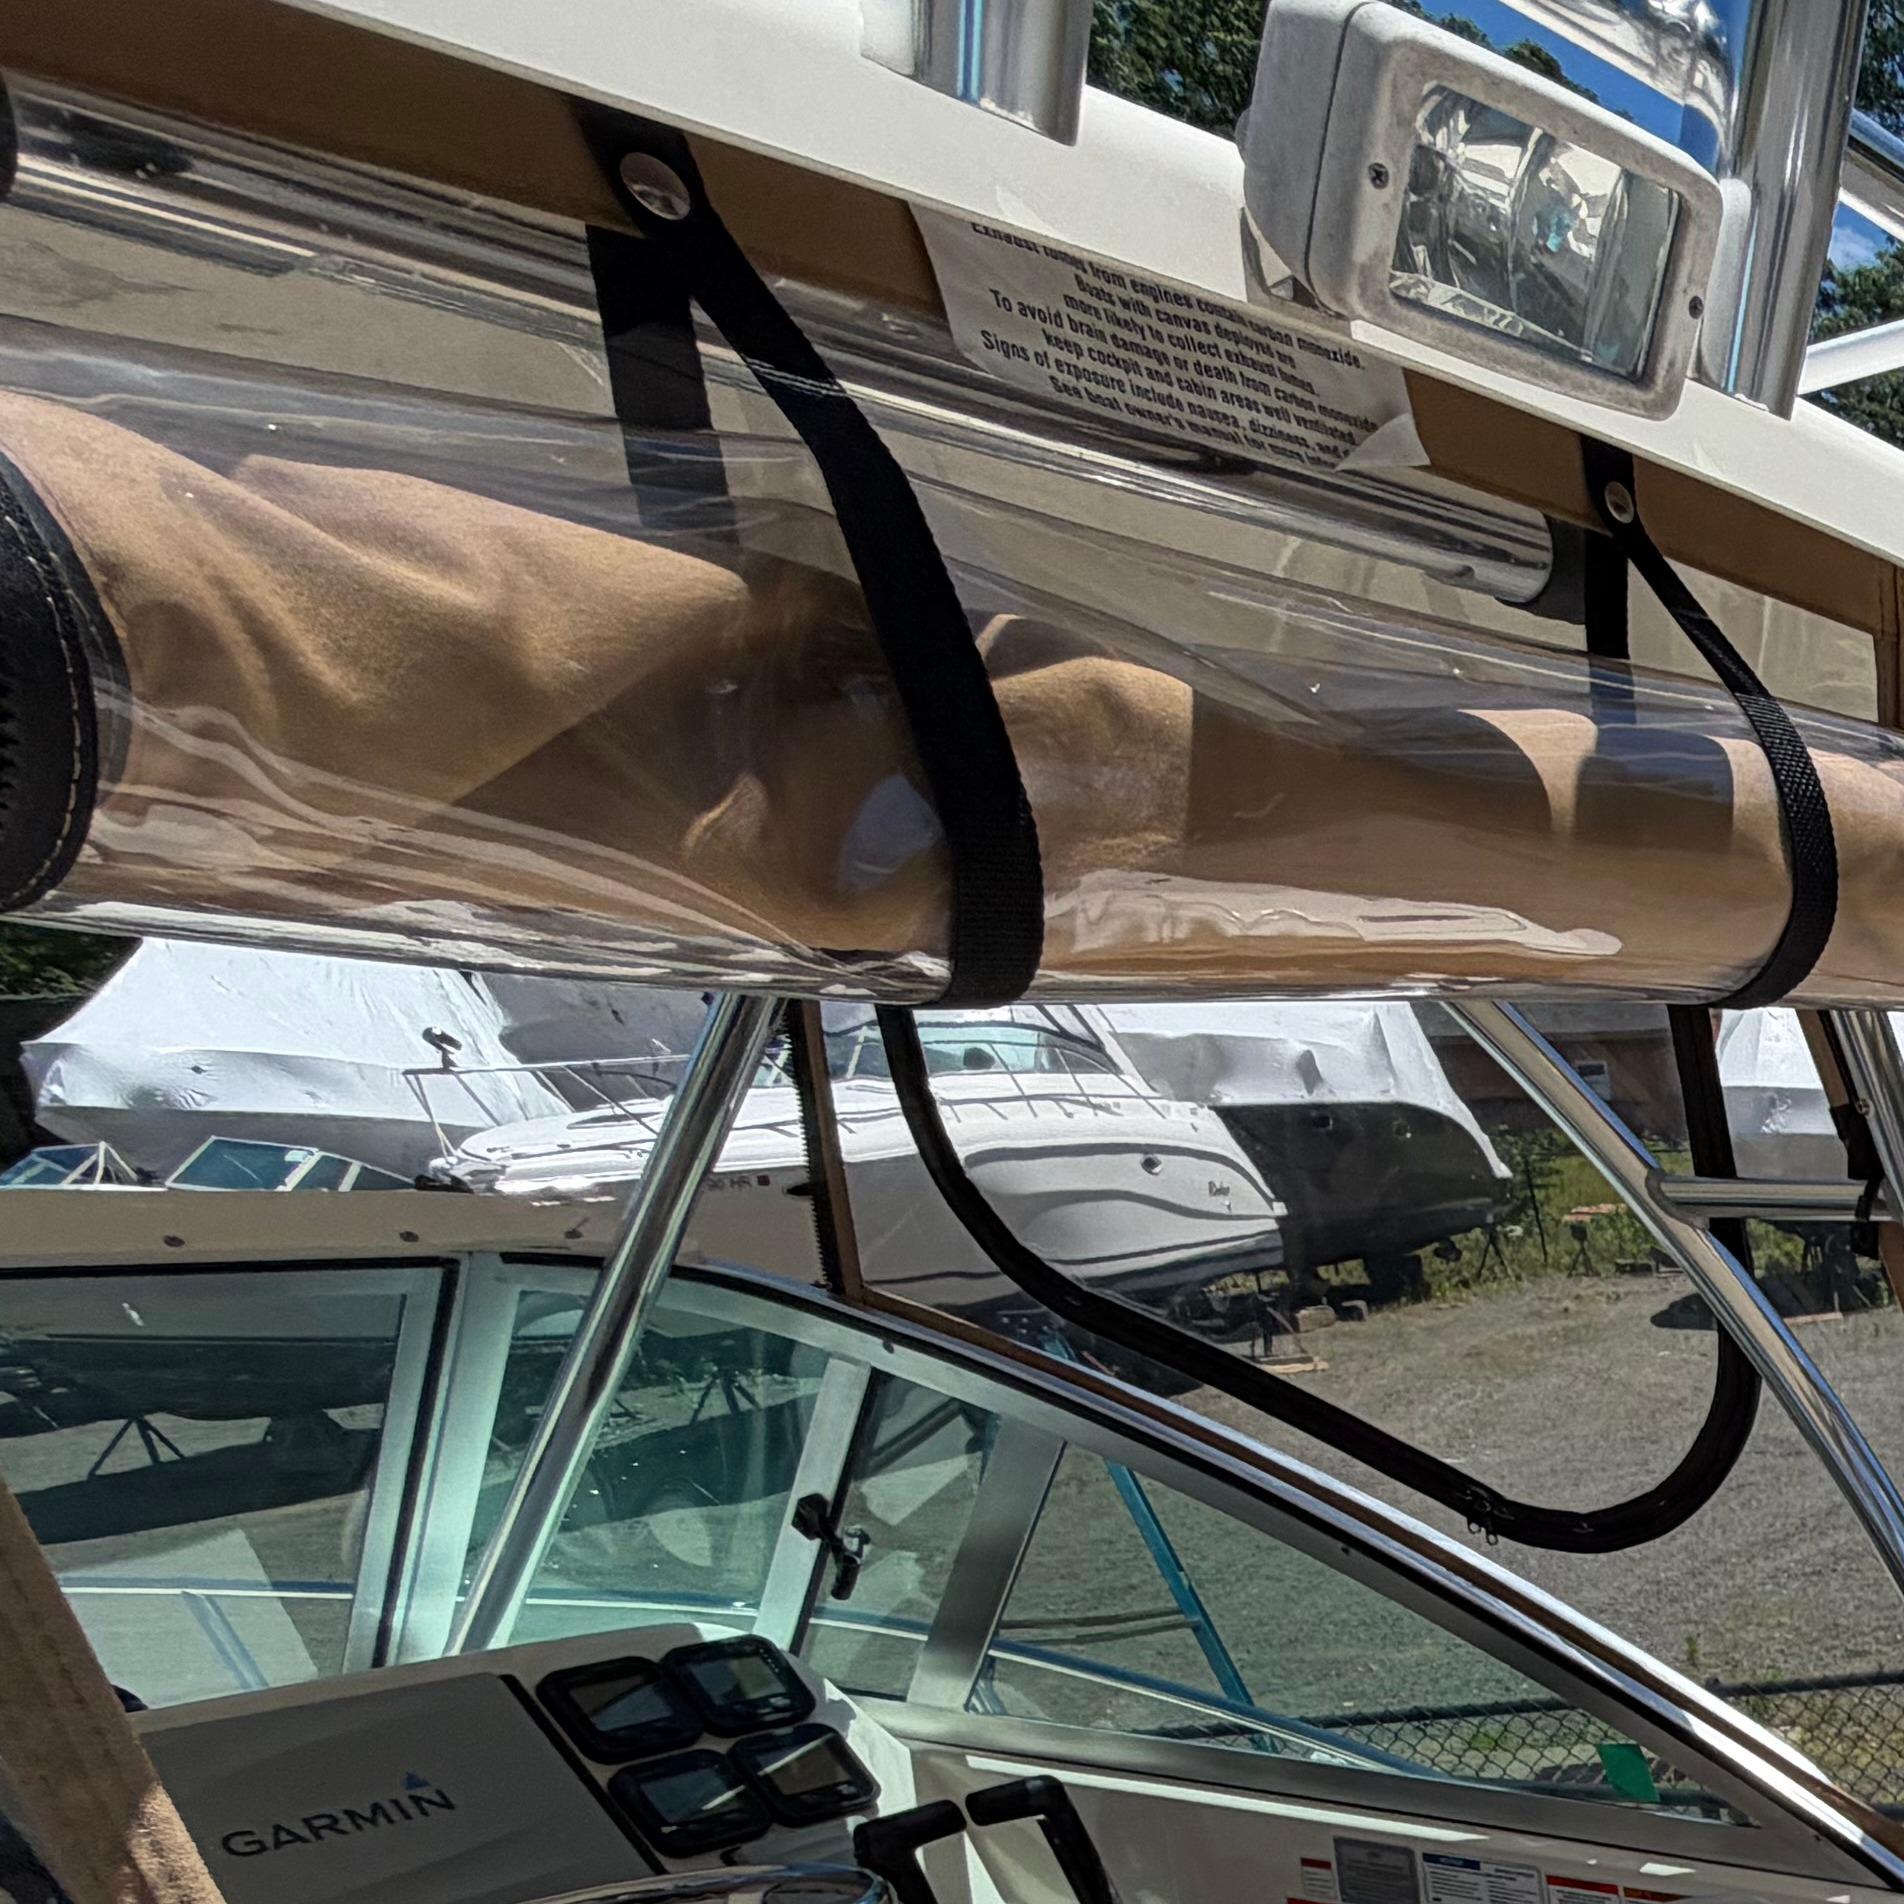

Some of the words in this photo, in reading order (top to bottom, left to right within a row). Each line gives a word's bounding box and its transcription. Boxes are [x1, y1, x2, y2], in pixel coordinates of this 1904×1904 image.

[1088, 261, 1128, 290] from
[1130, 278, 1194, 309] engines
[1117, 294, 1153, 318] with
[1155, 308, 1211, 335] canvas
[988, 287, 1013, 313] To
[1017, 300, 1065, 330] avoid
[1066, 313, 1108, 344] brain
[1110, 332, 1171, 367] damage
[1173, 354, 1189, 373] or
[1193, 359, 1239, 385] death
[1239, 370, 1272, 397] from
[1063, 293, 1102, 321] more
[1102, 307, 1147, 341] likely
[1147, 324, 1165, 344] to
[1167, 332, 1222, 360] collect
[980, 329, 1031, 362] Signs
[1034, 350, 1052, 370] of
[1054, 357, 1127, 394] exposure
[1128, 377, 1185, 412] include
[1041, 327, 1084, 361] keep
[1087, 345, 1144, 377] cockpit
[1144, 365, 1174, 388] and
[1175, 376, 1218, 401] cabin
[1220, 389, 1261, 414] areas
[1048, 374, 1083, 400] See
[1084, 386, 1124, 412] boat
[222, 1788, 456, 1857] GARMIN
